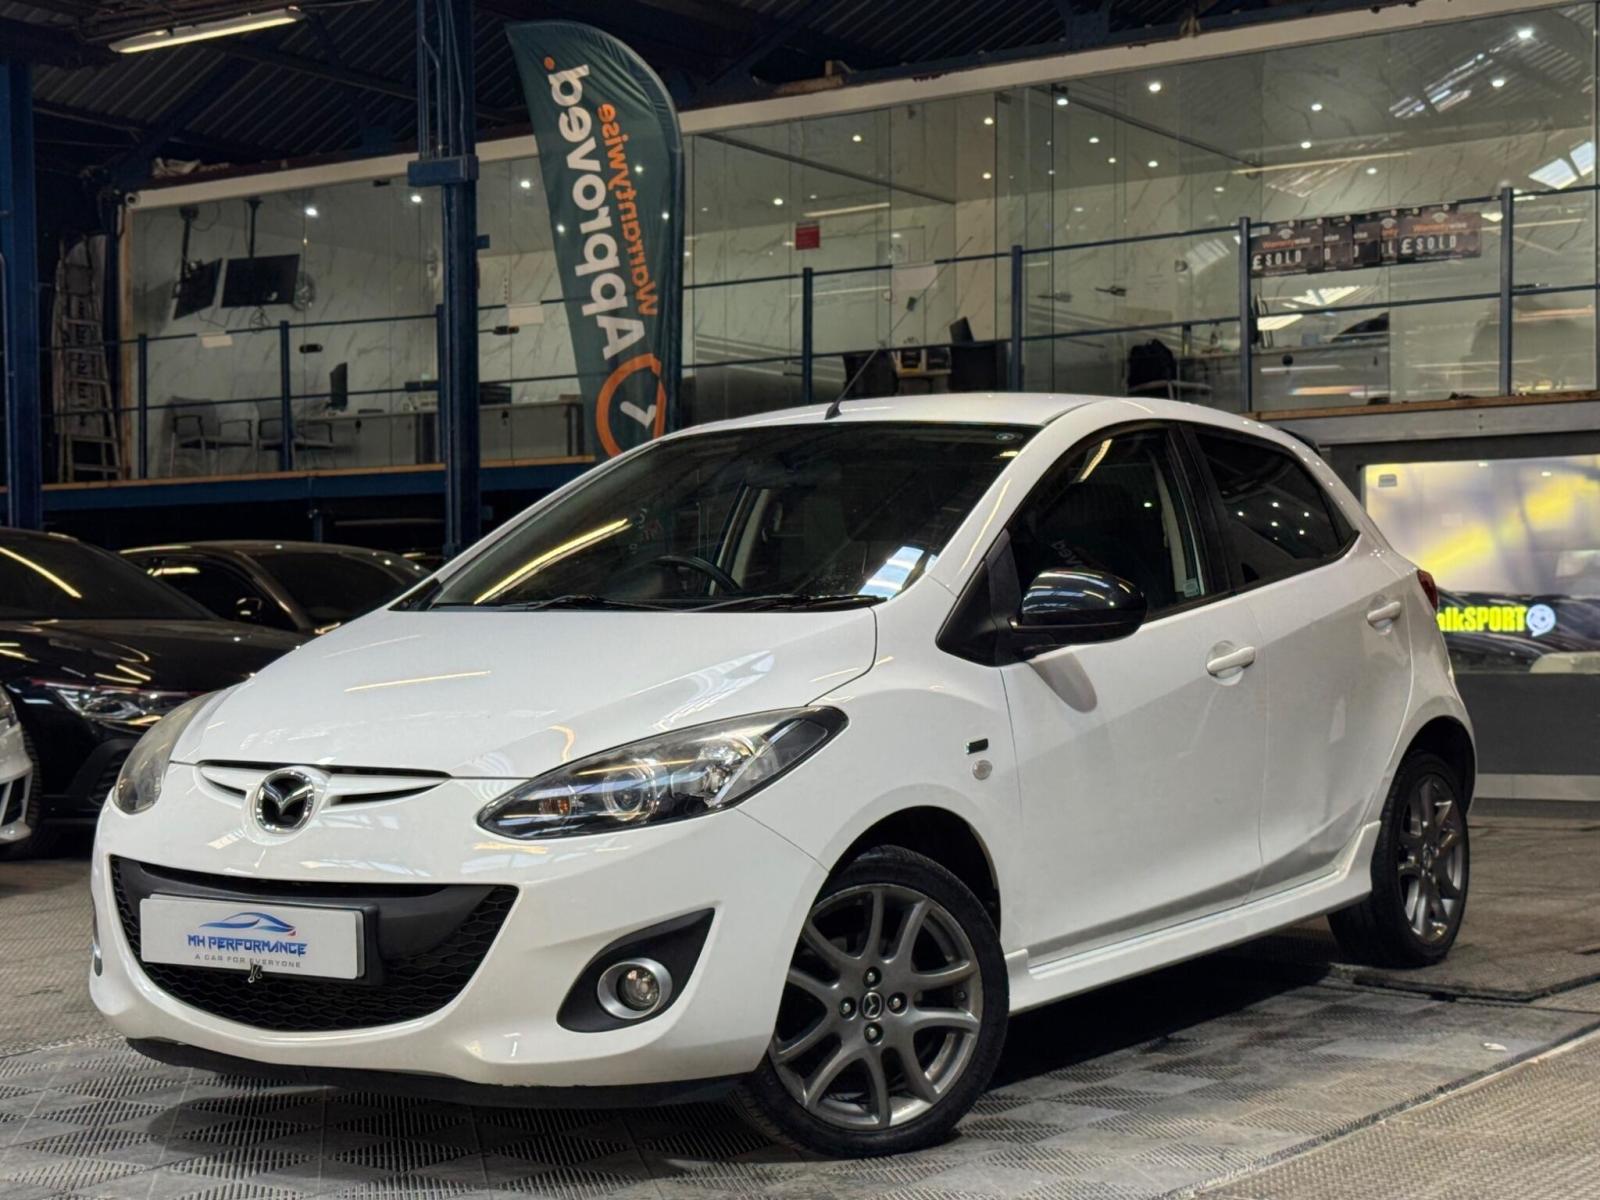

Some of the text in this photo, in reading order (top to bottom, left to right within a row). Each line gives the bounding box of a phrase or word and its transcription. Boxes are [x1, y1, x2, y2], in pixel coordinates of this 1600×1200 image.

[1436, 606, 1527, 632] alkSPORT
[187, 934, 308, 957] MH PERFORMANCE
[226, 955, 246, 963] FOR
